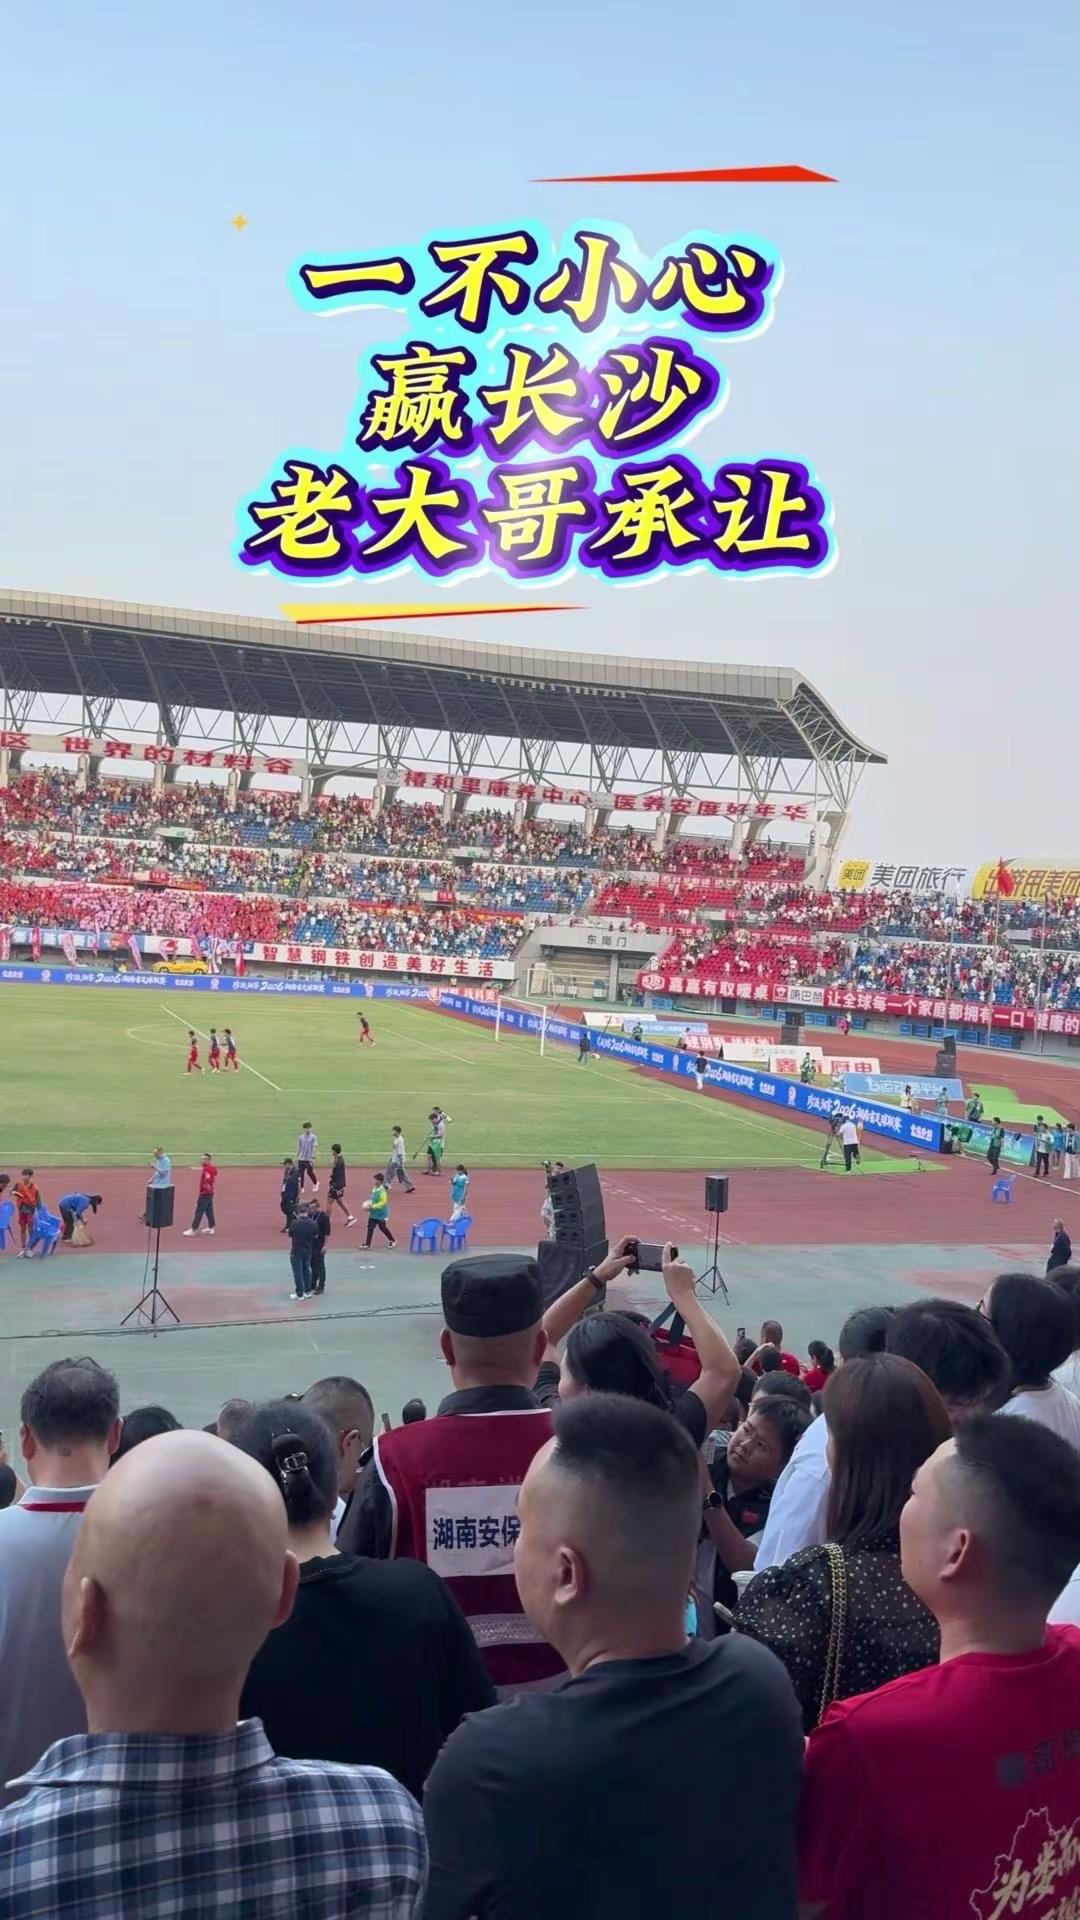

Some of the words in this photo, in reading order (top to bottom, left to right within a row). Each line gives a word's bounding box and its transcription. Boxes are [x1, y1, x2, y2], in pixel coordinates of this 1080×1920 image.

[62, 737, 294, 774] 世界的材料谷
[614, 794, 809, 821] 医养安度好年华
[842, 867, 866, 881] 美团
[870, 864, 967, 890] 美团旅行
[586, 934, 628, 948] 东南门
[262, 944, 495, 978] 智慧钢铁创造美好生活
[432, 1515, 521, 1550] 湖南安保
